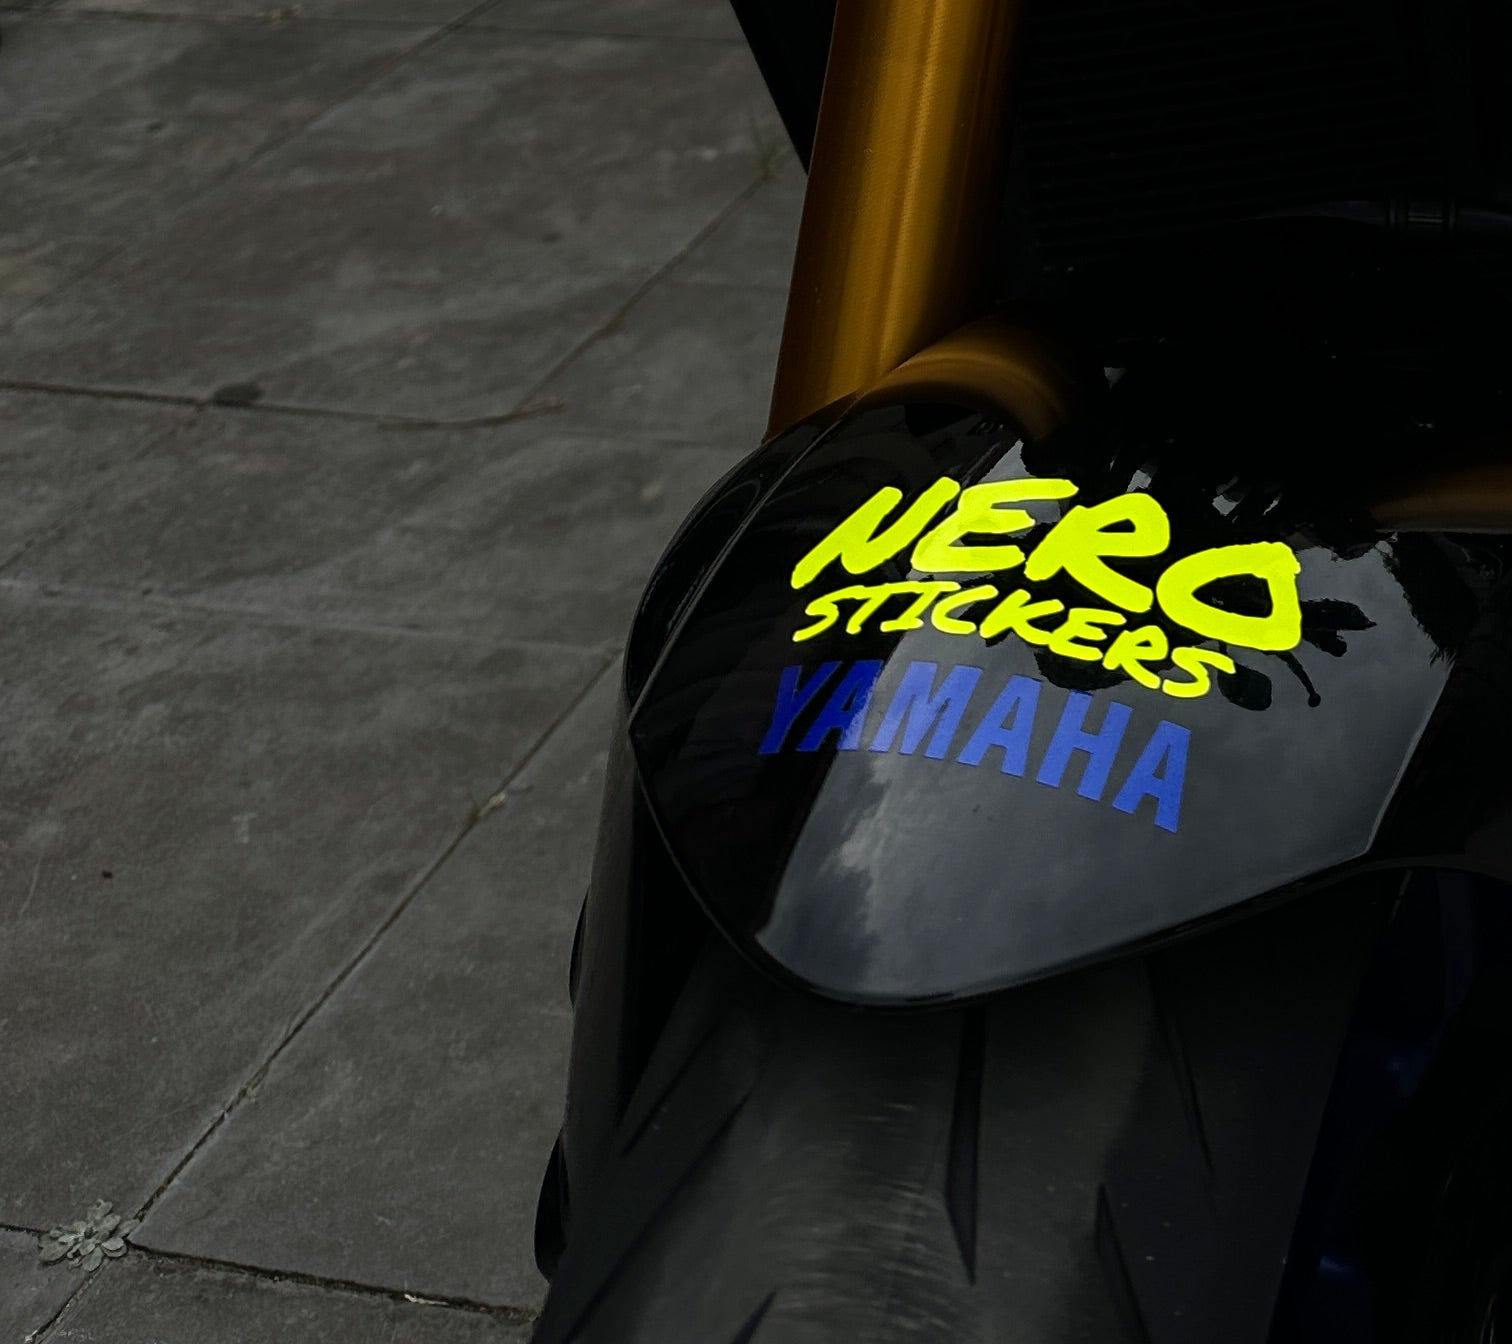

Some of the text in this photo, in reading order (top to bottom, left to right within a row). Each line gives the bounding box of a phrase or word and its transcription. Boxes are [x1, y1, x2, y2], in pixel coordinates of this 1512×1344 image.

[791, 476, 1302, 652] NERO
[791, 579, 1237, 699] STICKERS
[758, 659, 1192, 834] YAMAHA
